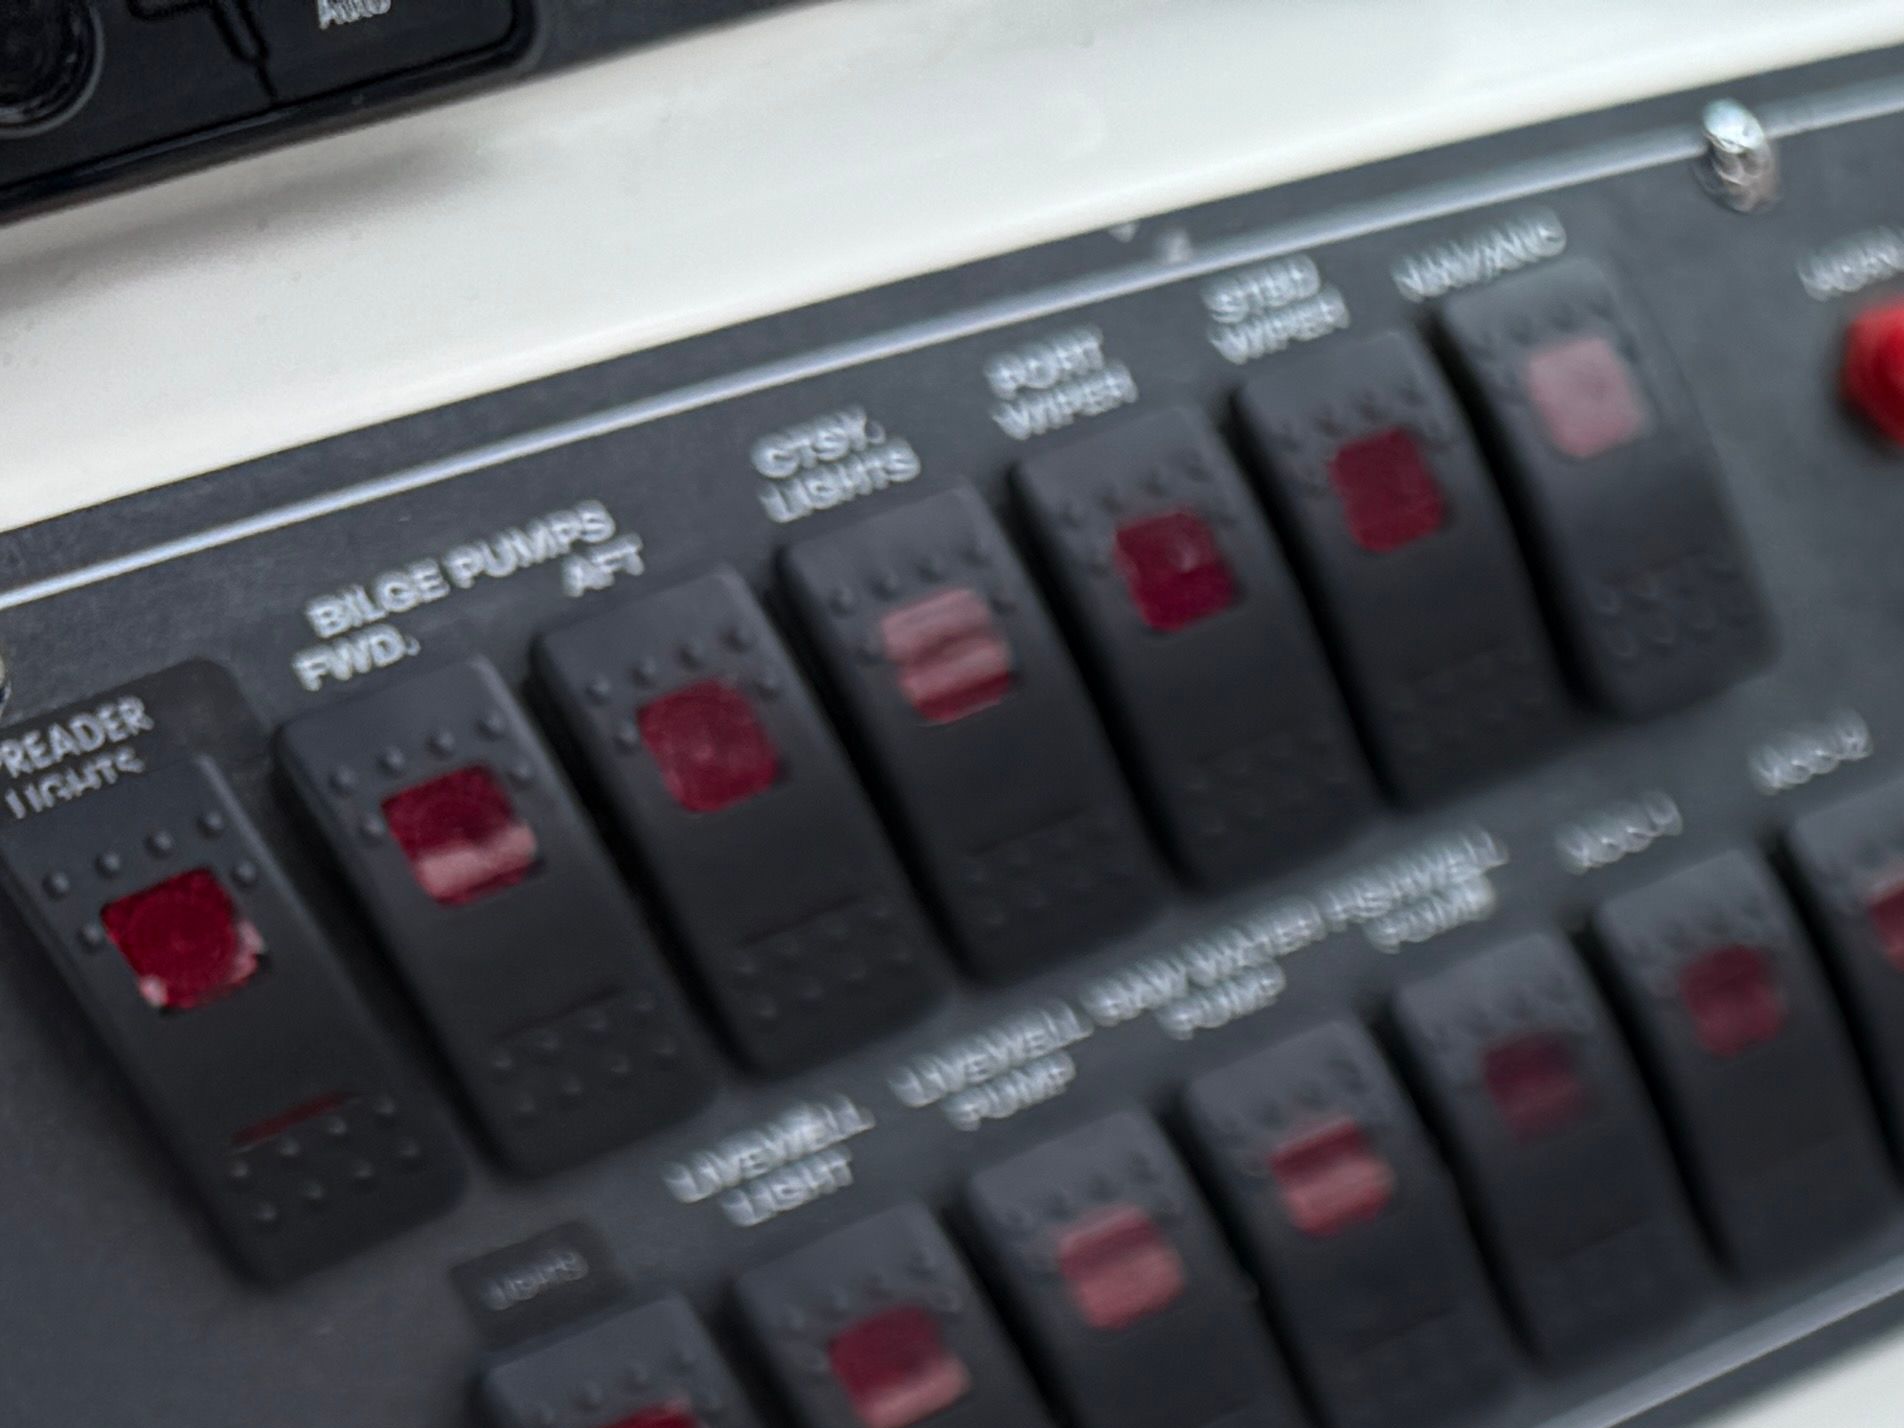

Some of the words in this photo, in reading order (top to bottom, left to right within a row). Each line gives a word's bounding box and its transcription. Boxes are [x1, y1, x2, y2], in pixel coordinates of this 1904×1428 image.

[758, 436, 921, 523] LIGHTS
[304, 557, 451, 638] BILGE
[442, 499, 616, 589] PUMPS
[561, 532, 645, 598] AFT
[0, 696, 155, 779] READER
